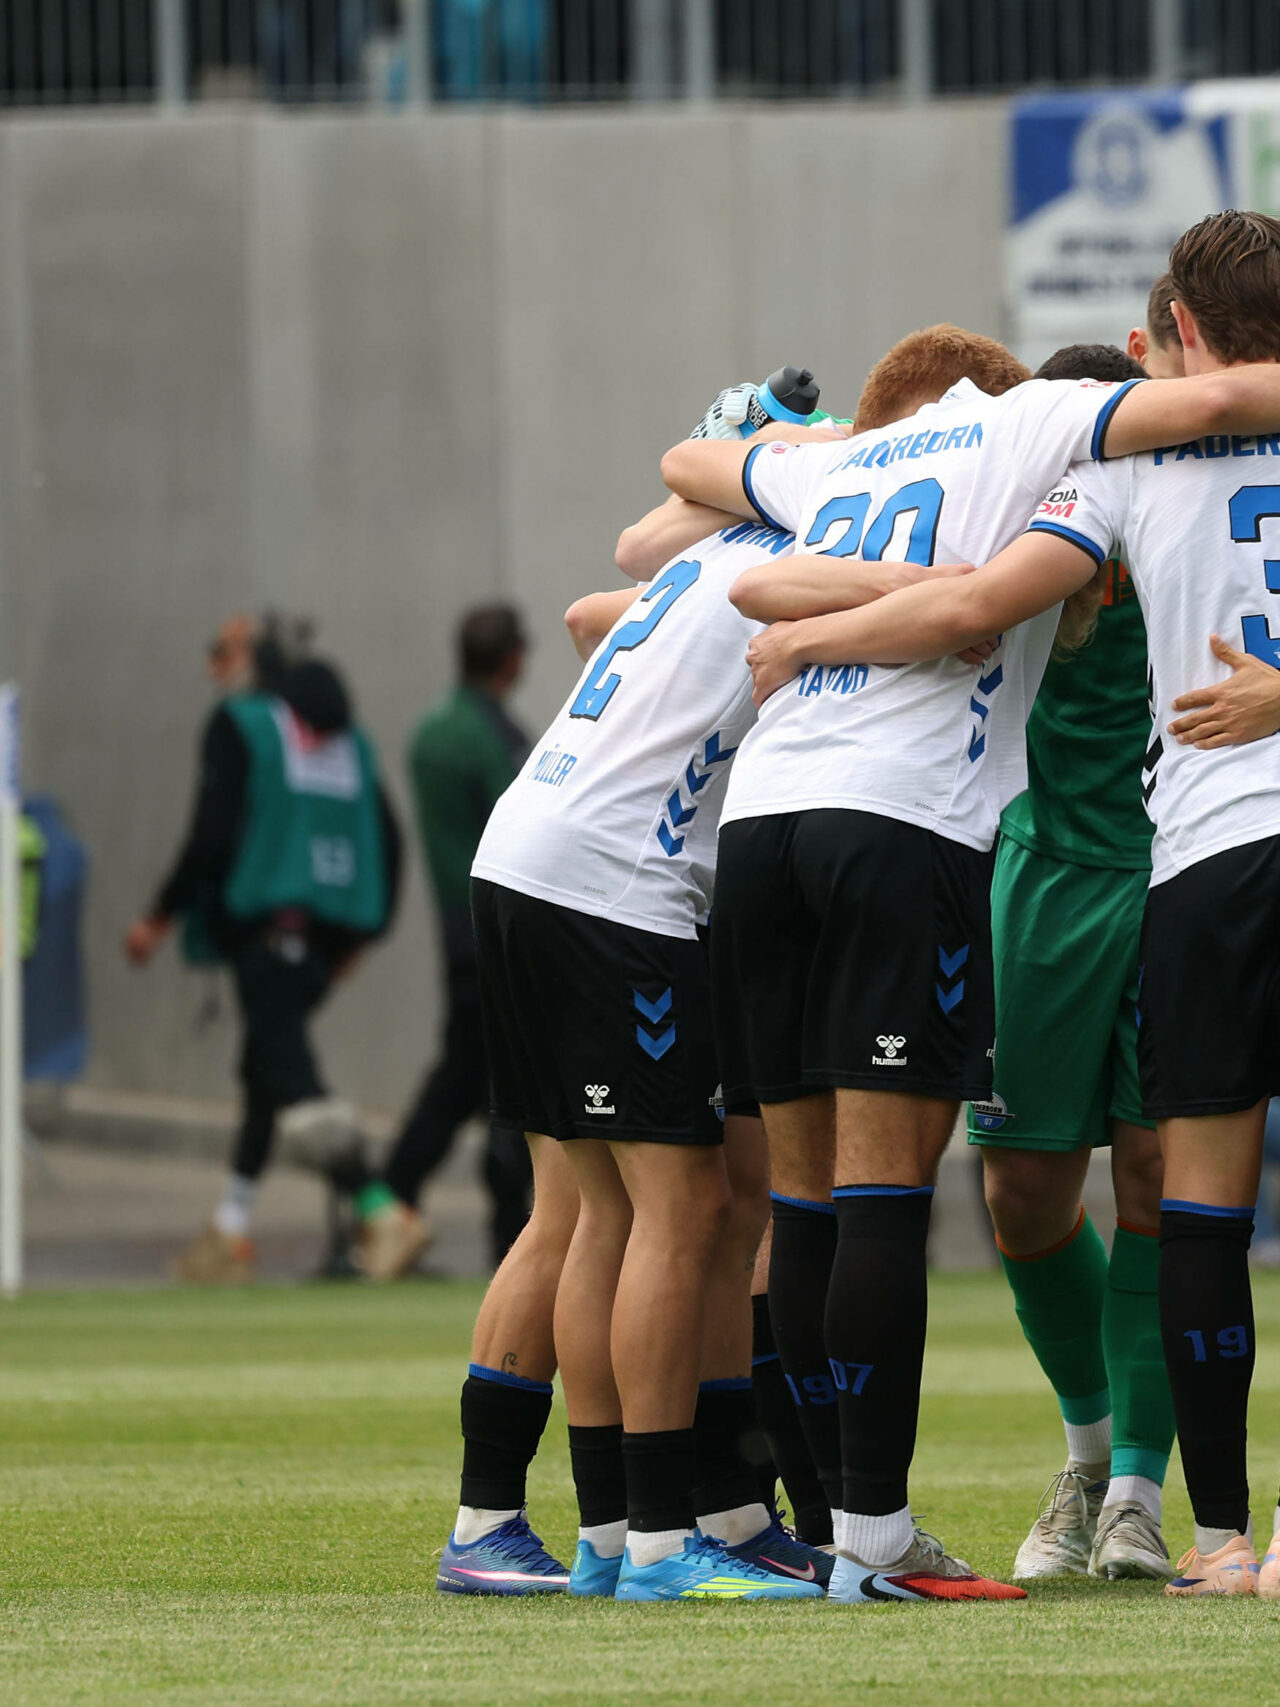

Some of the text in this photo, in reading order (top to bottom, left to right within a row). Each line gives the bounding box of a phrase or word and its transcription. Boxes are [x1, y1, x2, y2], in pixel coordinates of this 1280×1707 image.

[568, 559, 702, 723] 2
[872, 1055, 908, 1066] hummel
[584, 1104, 616, 1115] hummel
[1183, 1325, 1250, 1363] 19
